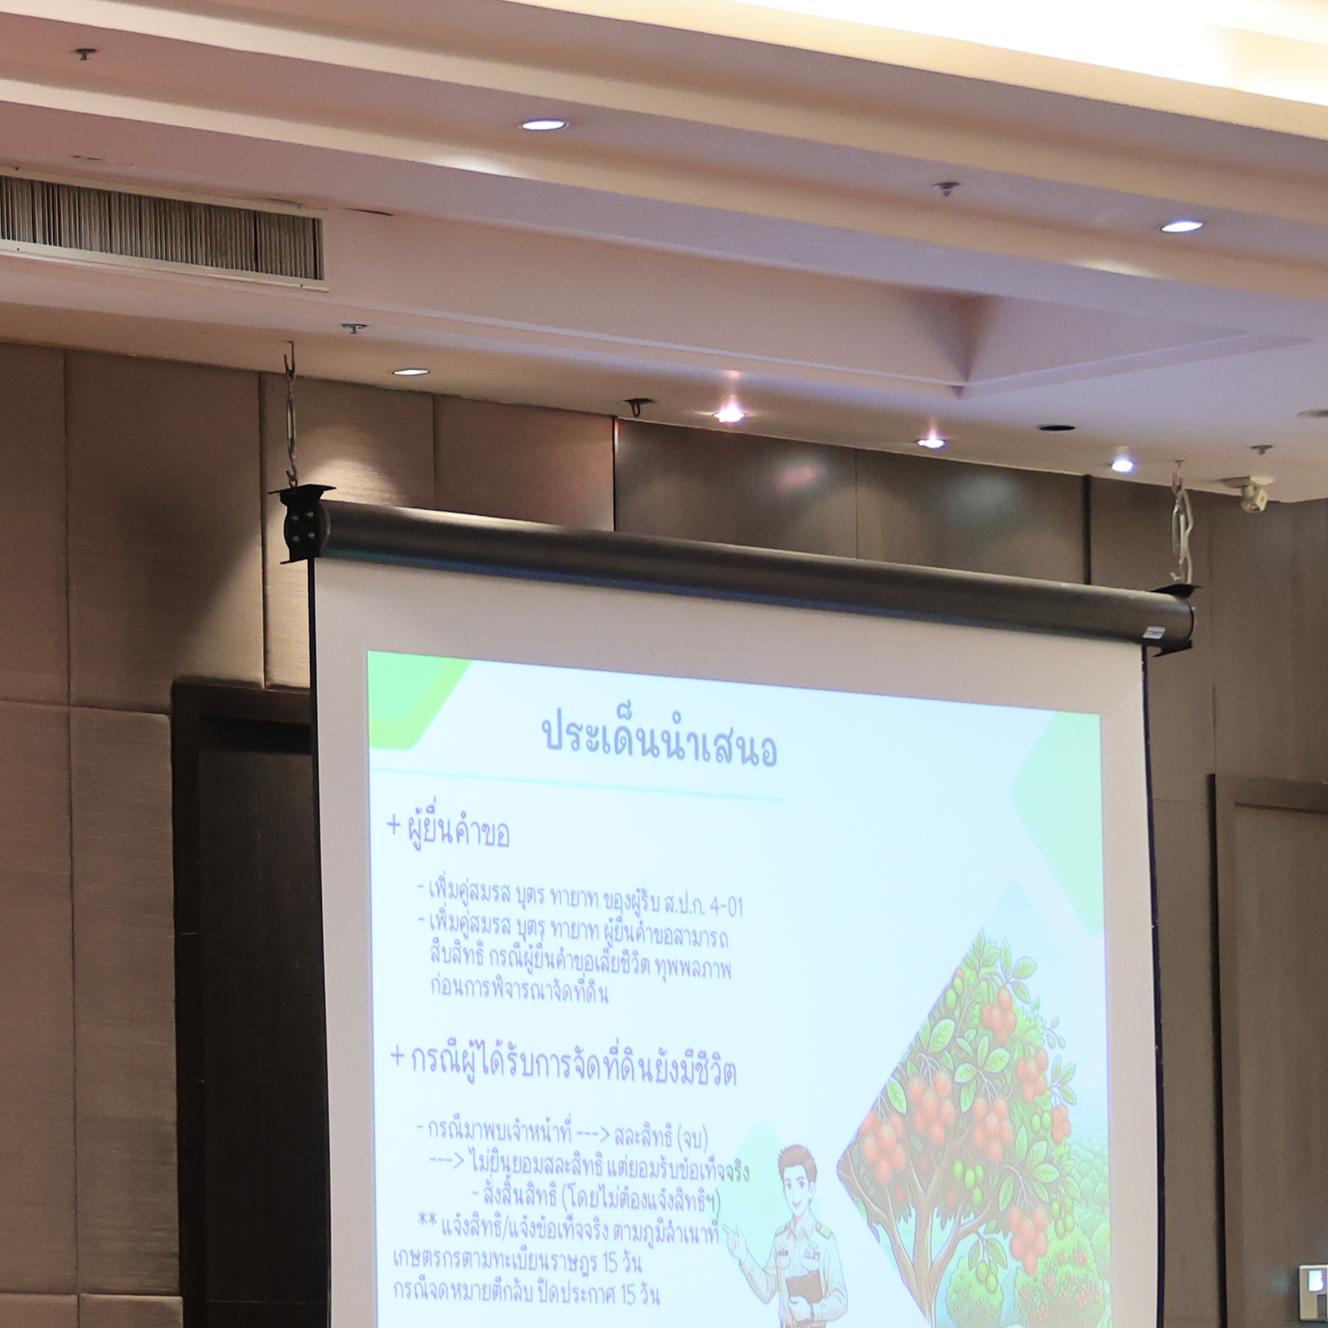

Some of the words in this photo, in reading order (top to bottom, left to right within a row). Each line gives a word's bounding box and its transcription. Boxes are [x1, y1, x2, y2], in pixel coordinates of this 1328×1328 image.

[542, 700, 777, 767] ประเด็นนำเสนอ
[407, 797, 510, 851] ผู้ยื่นคำขอ
[429, 870, 511, 907] เพิ่มคู่สมรส
[516, 884, 545, 911] บุตร
[550, 887, 599, 909] ทายาท
[603, 887, 660, 918] ของผู้รับ
[665, 890, 706, 915] ส.ป.ก.
[709, 895, 744, 918] 4-01
[430, 902, 511, 939] เพิ่มคู่สมรส
[516, 915, 545, 943] บุตร
[551, 920, 600, 941] ทายาท
[604, 914, 729, 949] ผู้ยื่นคำขอสามารถ
[431, 971, 610, 1005] ก่อนการพิจารณาจัดที่ดิน
[655, 956, 732, 983] ทุพพลภาพ
[411, 1037, 737, 1086] กรณีผู้ได้รับการจัดที่ดินยังมีชีวิต
[428, 1113, 572, 1144] กรณีมาพบเจ้าหน้าที่
[614, 1123, 673, 1148] สละสิทธิ
[677, 1123, 708, 1153] (จบ)
[469, 1146, 603, 1177] ไม่ยินยอมสละสิทธิ
[603, 1251, 618, 1273] 15
[623, 1251, 643, 1275] วัน
[394, 1273, 534, 1304] กรณีจดหมายตีกลับ
[538, 1279, 615, 1306] ปิดประกาศ
[621, 1283, 636, 1306] 15
[640, 1281, 661, 1307] วัน
